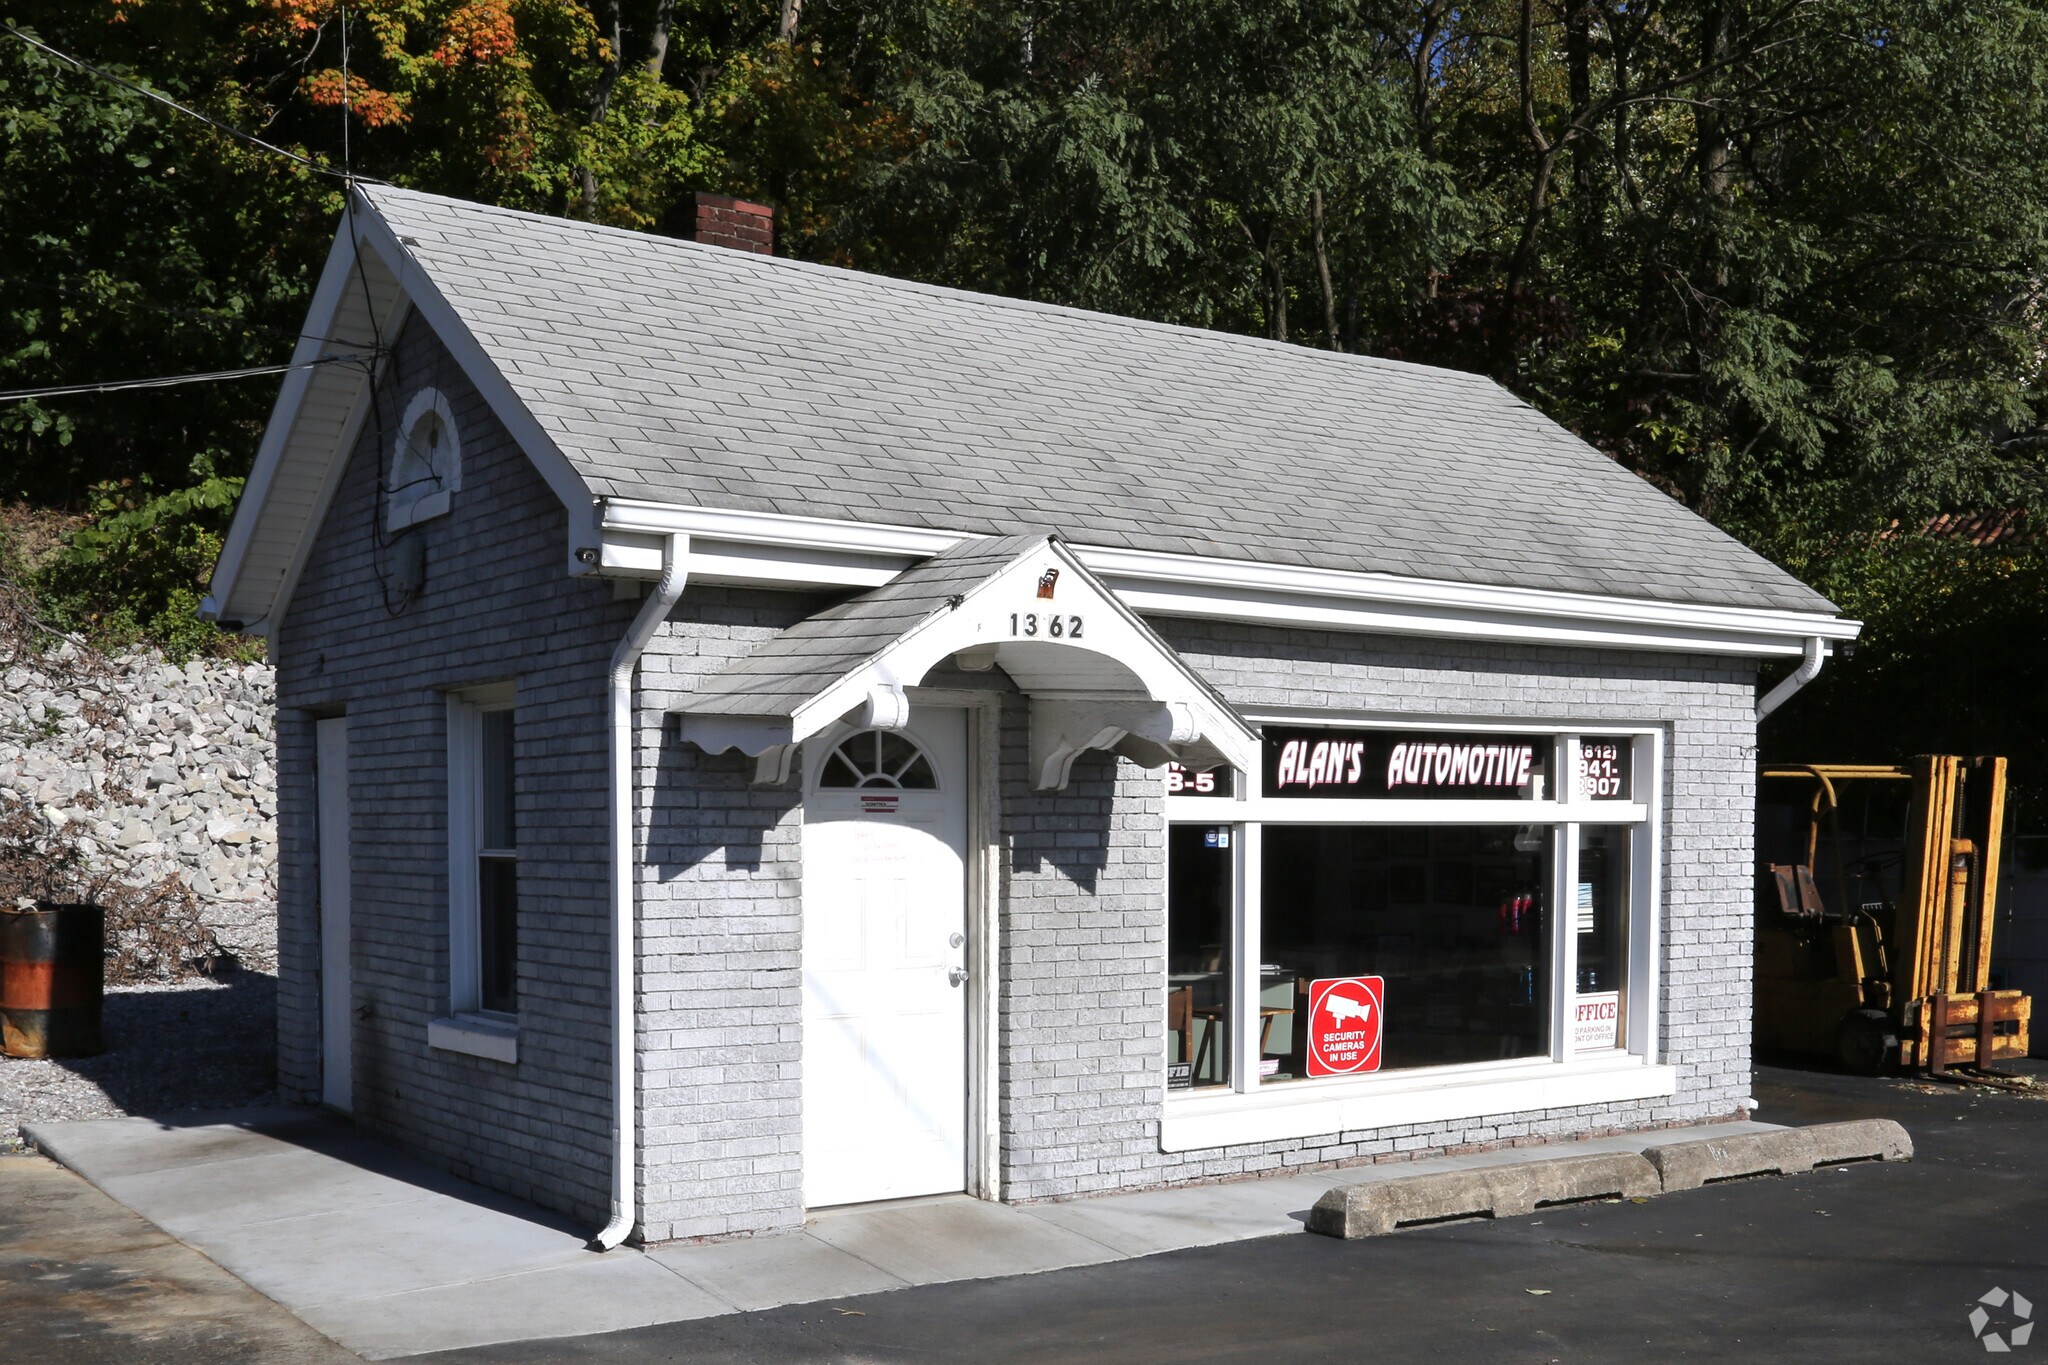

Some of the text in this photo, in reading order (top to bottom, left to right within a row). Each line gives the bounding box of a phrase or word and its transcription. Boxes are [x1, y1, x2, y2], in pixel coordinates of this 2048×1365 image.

[1010, 613, 1083, 638] 1362
[1580, 744, 1617, 760] (812)
[1278, 740, 1533, 790] ALAN'S AUTOMOTIVE
[1580, 760, 1618, 777] 941-
[1575, 1002, 1616, 1022] FFICE
[1323, 1030, 1366, 1042] SECURITY
[1580, 1026, 1604, 1034] PARKING
[1323, 1041, 1365, 1052] CAMERAS
[1329, 1052, 1358, 1062] IN USE
